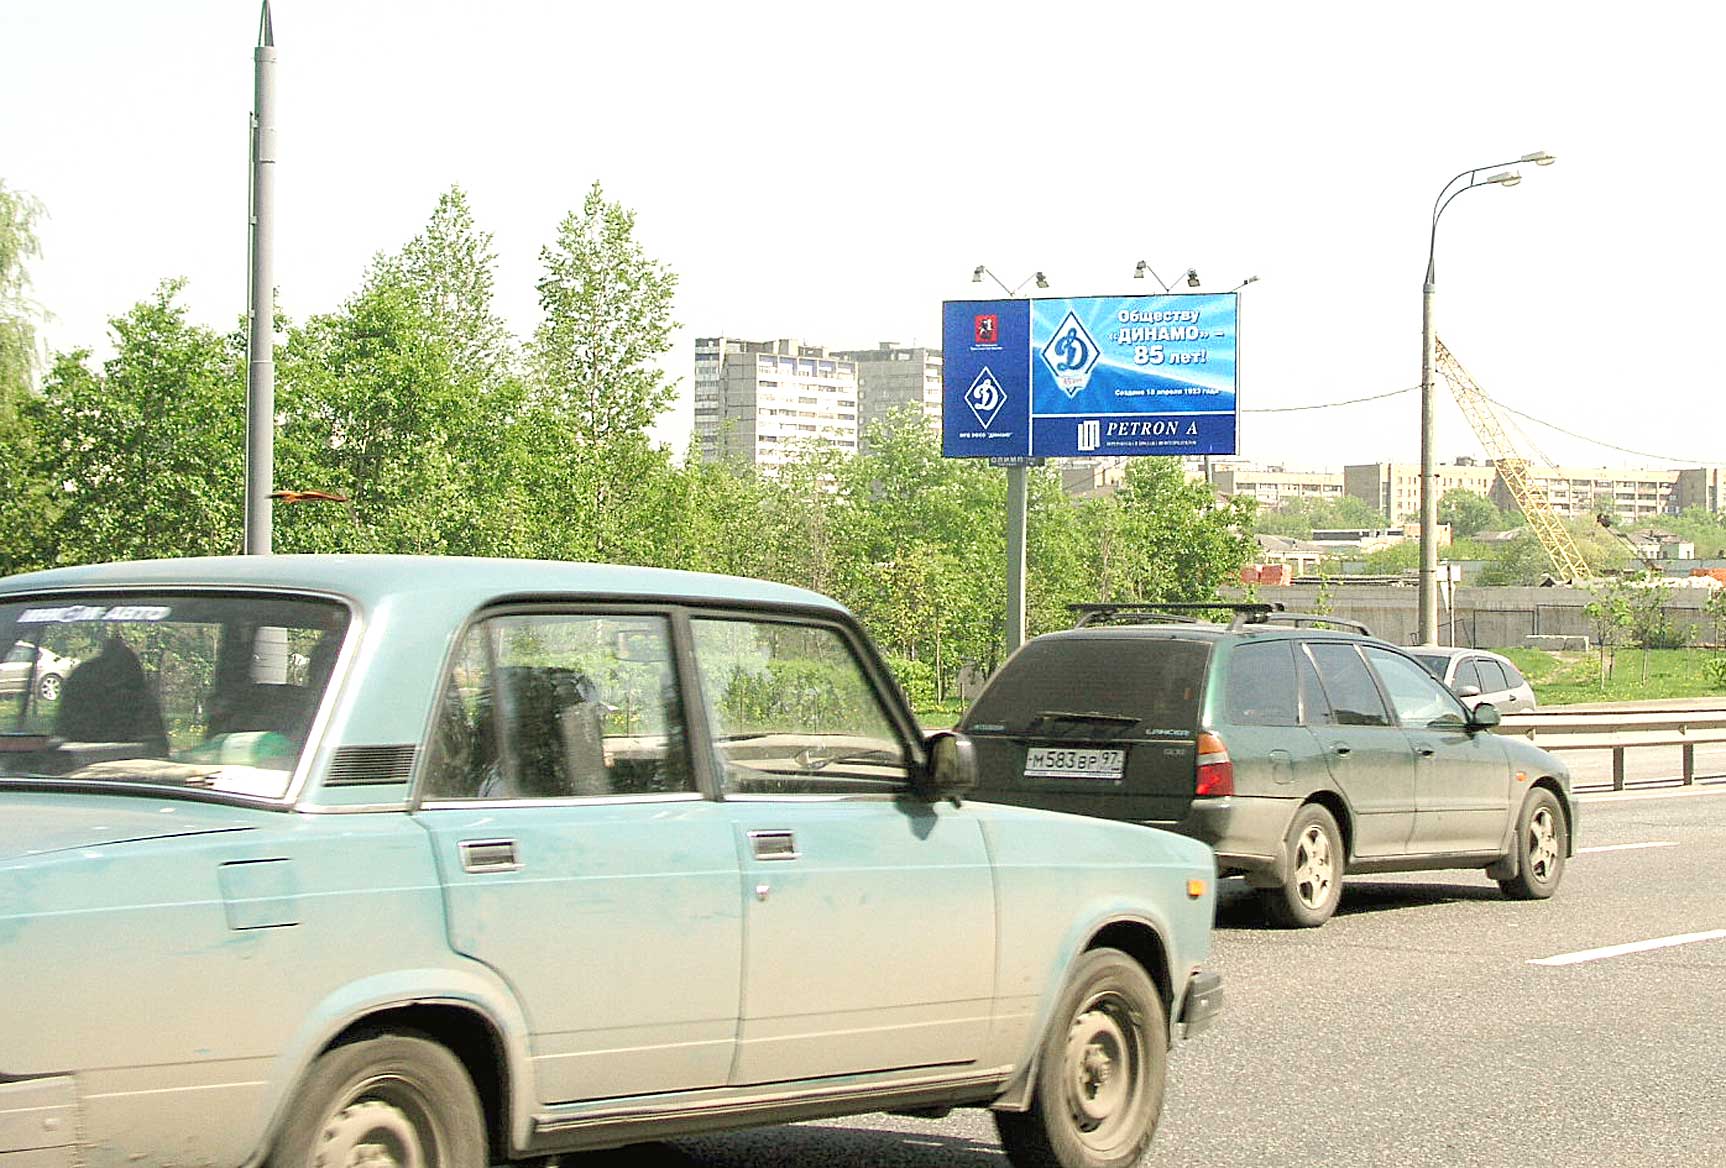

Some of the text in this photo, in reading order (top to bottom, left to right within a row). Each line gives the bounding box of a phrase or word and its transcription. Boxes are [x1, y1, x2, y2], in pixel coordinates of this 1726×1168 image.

[1117, 310, 1200, 325] Обществу
[1108, 326, 1210, 346] «ДИНАМО»
[1133, 345, 1208, 366] 85 лет!
[1106, 420, 1199, 436] PETRON A
